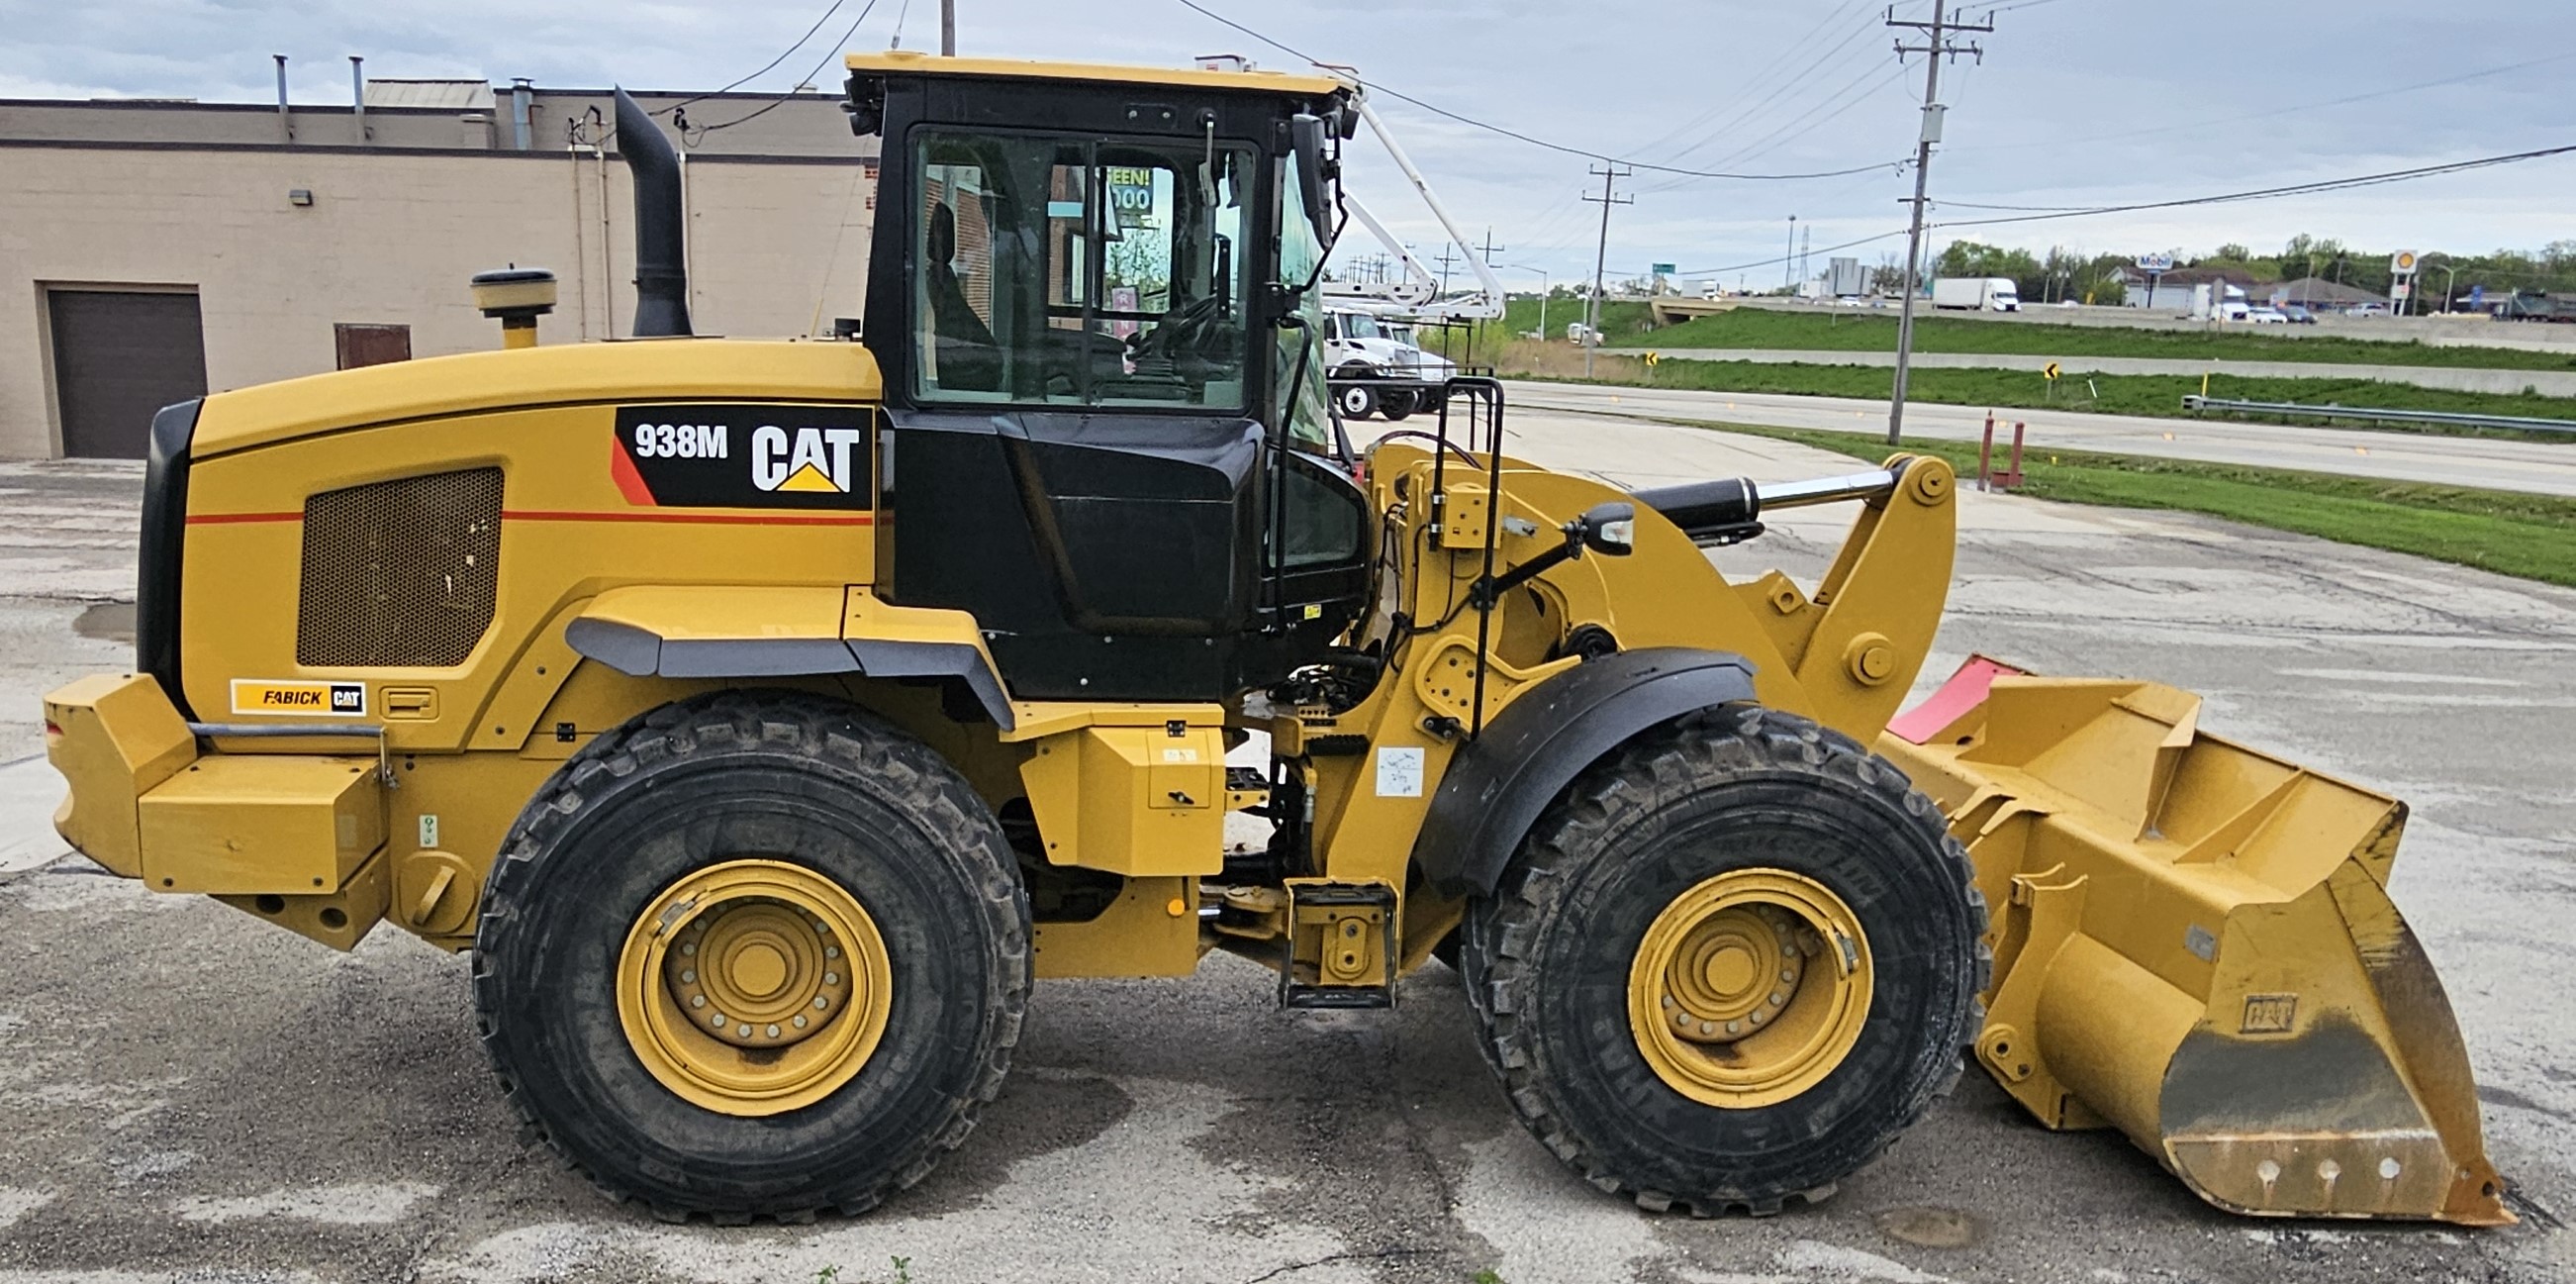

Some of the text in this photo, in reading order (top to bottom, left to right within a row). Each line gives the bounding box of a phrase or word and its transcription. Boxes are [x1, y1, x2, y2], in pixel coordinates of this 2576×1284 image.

[2140, 255, 2170, 266] Mobil
[635, 424, 728, 459] 938M
[752, 425, 860, 493] CAT
[263, 690, 322, 705] FABICK
[334, 691, 360, 706] CAT
[2246, 1001, 2291, 1030] CAT
